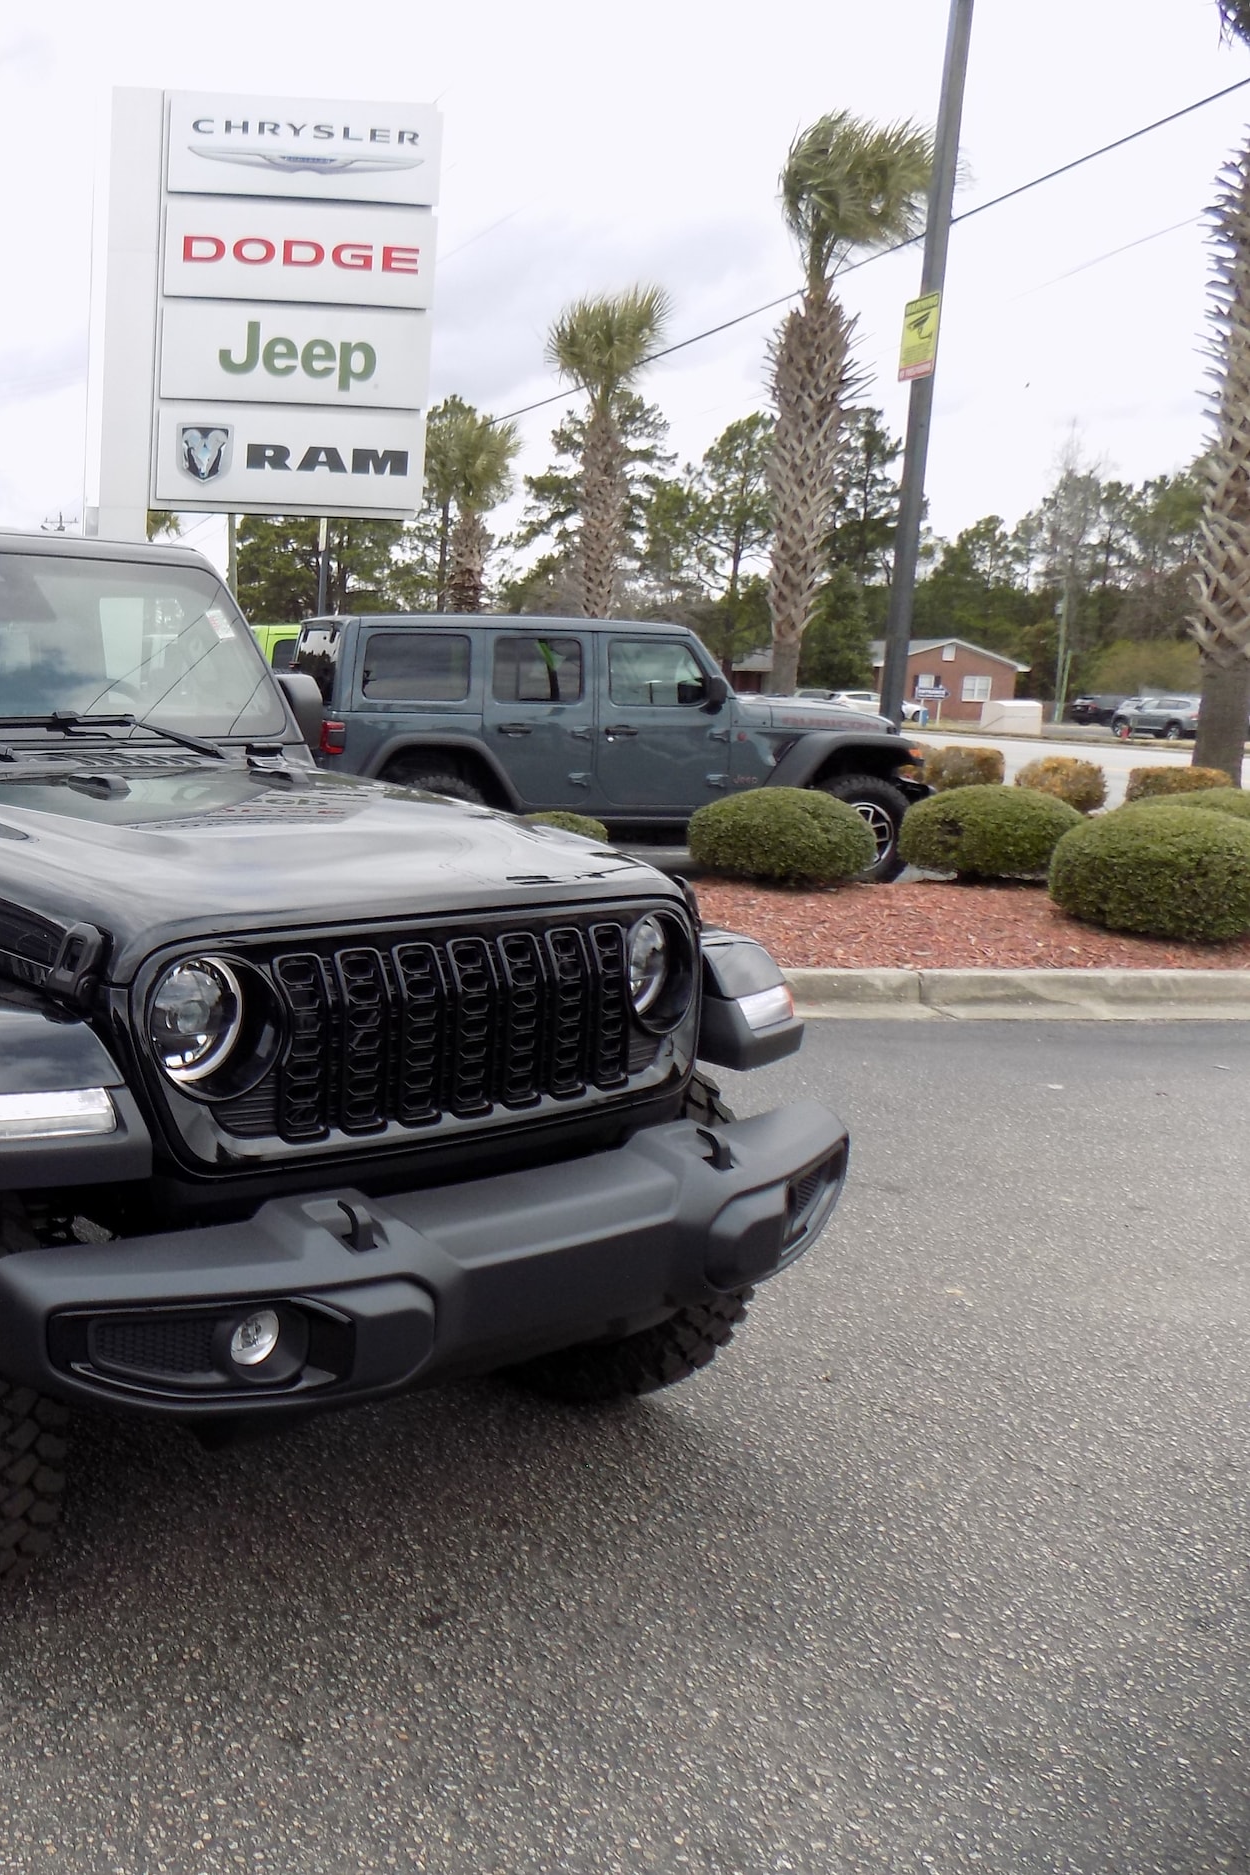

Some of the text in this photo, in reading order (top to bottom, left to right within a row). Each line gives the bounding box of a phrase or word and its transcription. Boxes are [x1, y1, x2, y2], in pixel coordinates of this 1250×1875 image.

[191, 118, 420, 147] CHRYSLER
[182, 235, 420, 275] DODGE
[218, 321, 377, 392] Jeep
[246, 443, 409, 477] RAM
